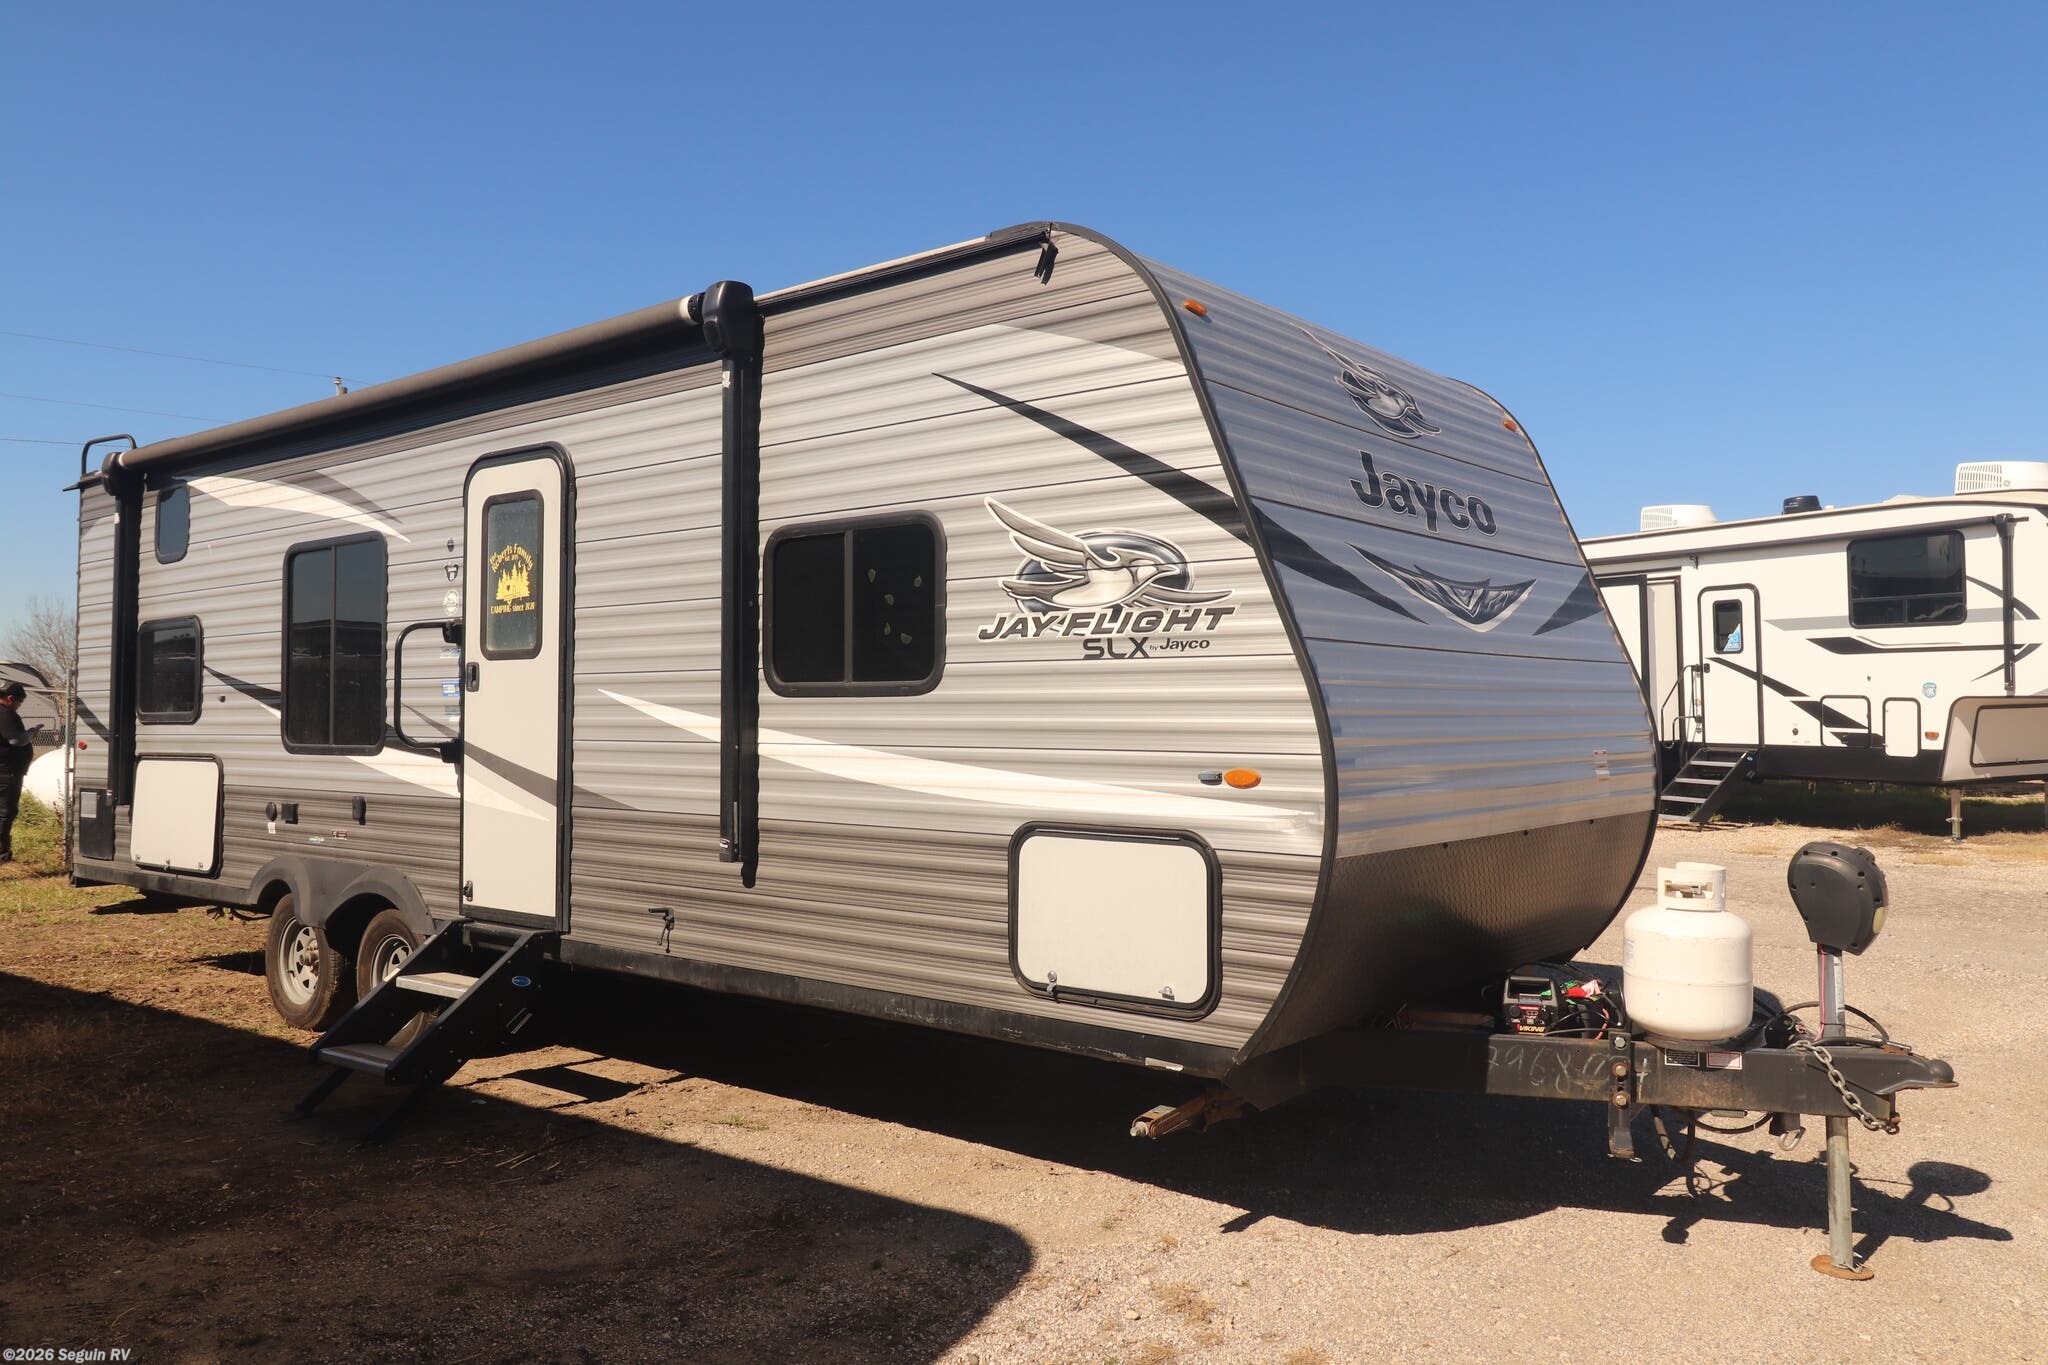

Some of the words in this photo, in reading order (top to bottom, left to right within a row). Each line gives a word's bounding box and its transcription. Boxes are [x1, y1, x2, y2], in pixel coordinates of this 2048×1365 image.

[1350, 449, 1498, 536] Jayco
[978, 613, 1059, 642] JAY
[1061, 606, 1237, 638] FLIGHT
[1082, 636, 1151, 660] SLX
[1150, 643, 1160, 652] by
[1159, 637, 1210, 652] Jayco
[1519, 1025, 1546, 1033] VIKING
